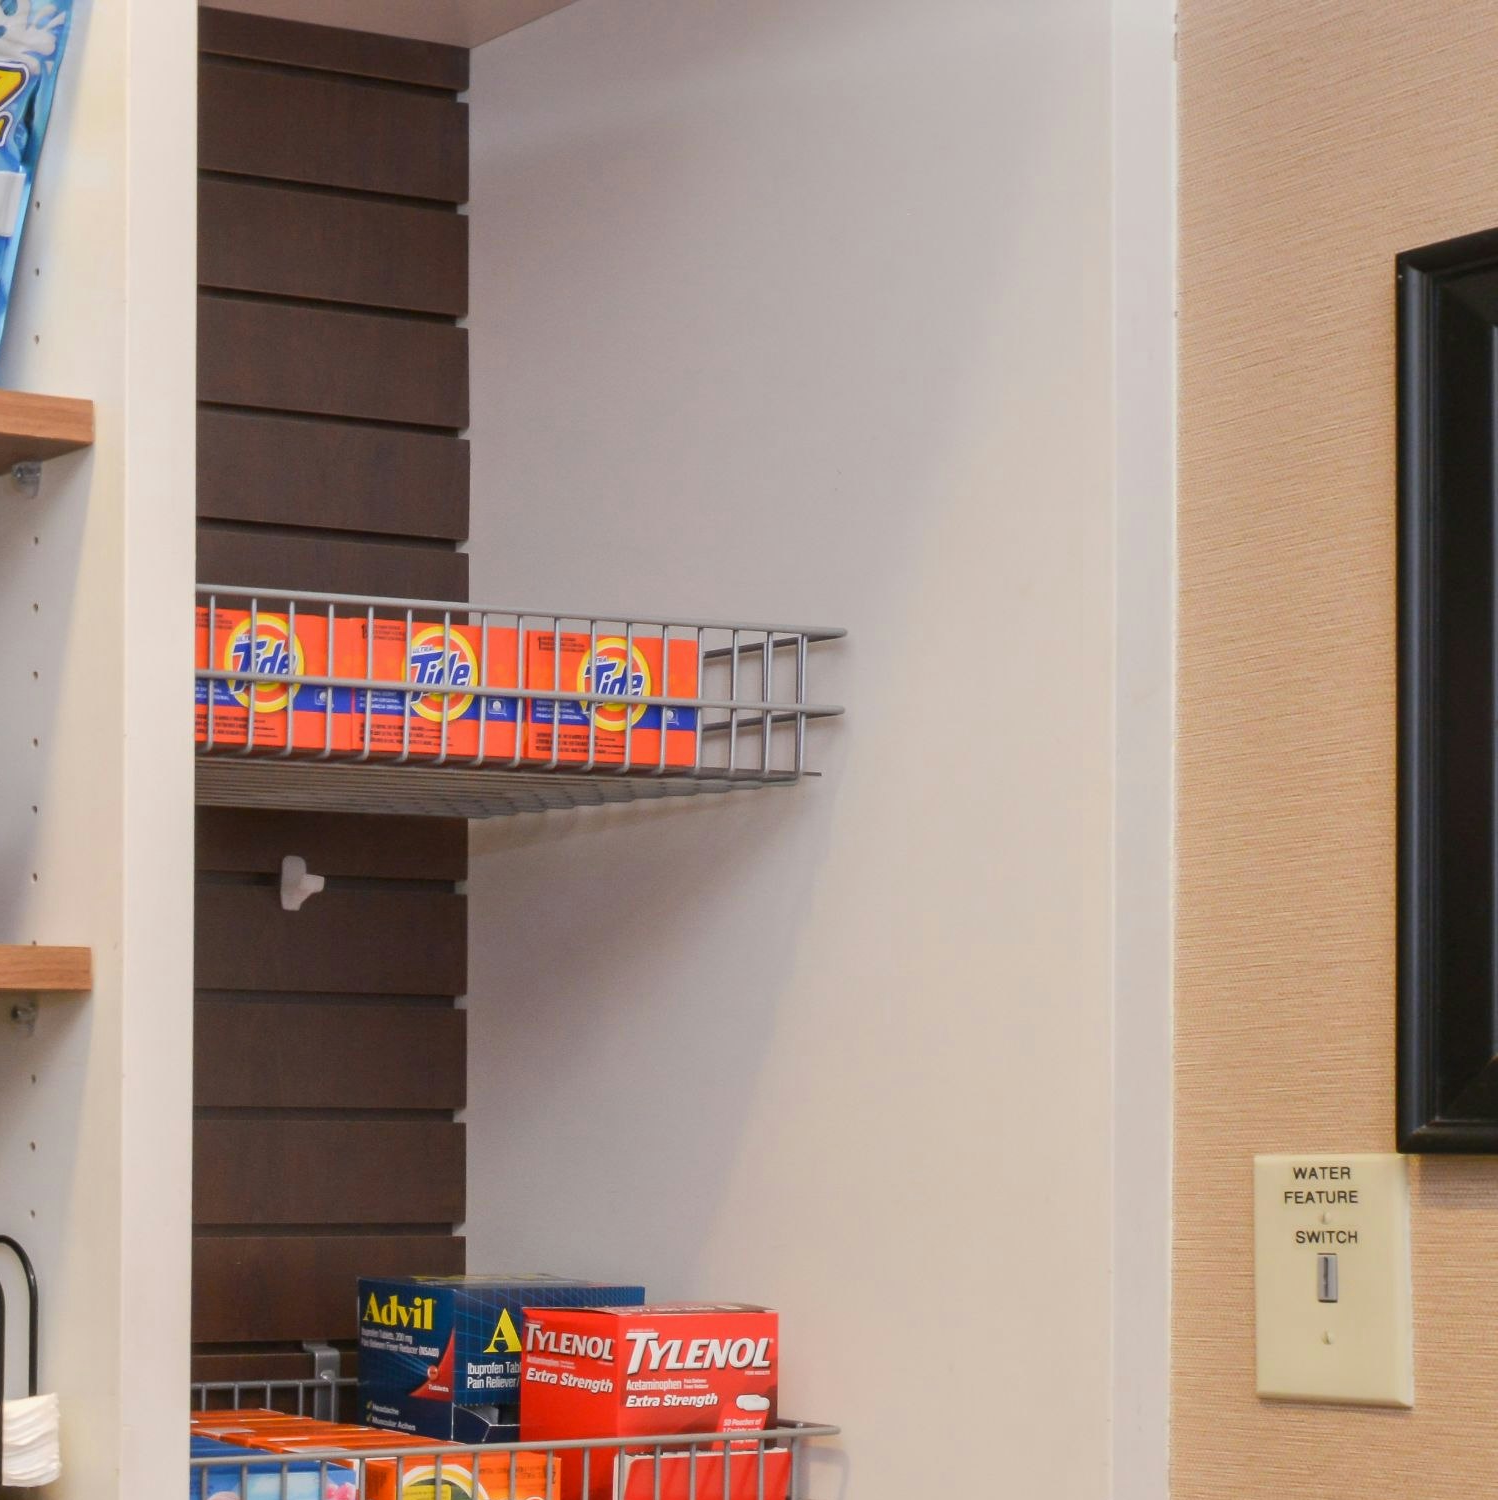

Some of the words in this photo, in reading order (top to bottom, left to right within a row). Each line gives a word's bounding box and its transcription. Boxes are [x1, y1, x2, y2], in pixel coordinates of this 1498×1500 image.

[231, 640, 296, 694] Tide
[410, 651, 471, 705] Tide
[583, 661, 643, 715] Tide
[1293, 1166, 1350, 1179] WATER
[1284, 1191, 1358, 1204] FEATURE
[1296, 1231, 1357, 1244] SWITCH
[363, 1291, 433, 1330] Advil
[526, 1323, 613, 1360] TYLENOL
[626, 1332, 770, 1375] TYLENOL
[467, 1362, 503, 1376] Ibuprofen
[467, 1377, 484, 1388] Pain
[526, 1368, 557, 1384] Extra
[560, 1373, 613, 1393] Strength
[626, 1380, 682, 1391] Acetaminophen
[626, 1395, 659, 1408] Extra
[663, 1393, 718, 1408] Strength
